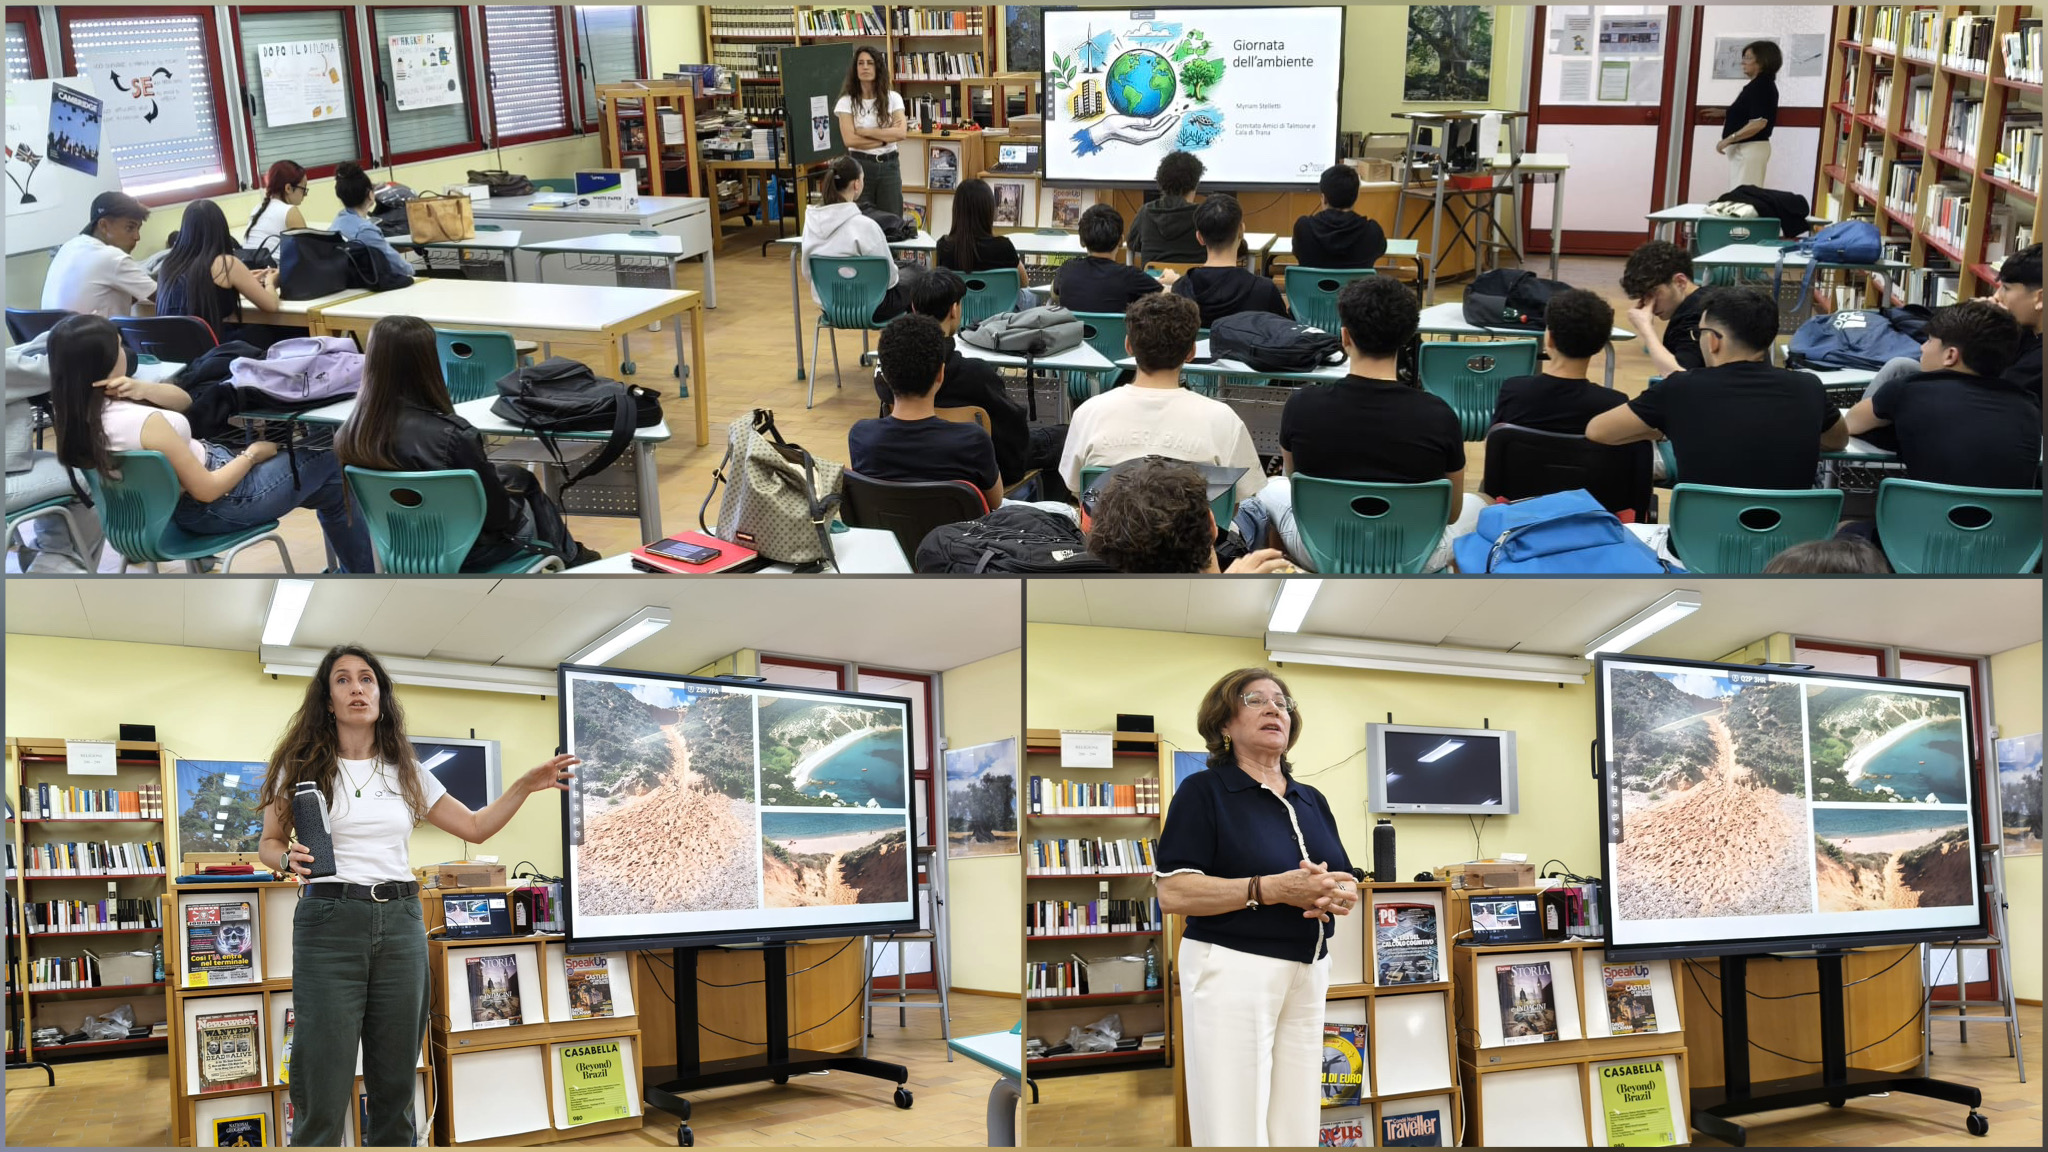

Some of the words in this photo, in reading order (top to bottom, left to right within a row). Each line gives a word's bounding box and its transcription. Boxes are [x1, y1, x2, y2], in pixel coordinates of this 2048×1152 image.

[1233, 39, 1285, 51] Giornata
[263, 46, 286, 58] DOPO
[1233, 55, 1314, 67] dell'ambiente
[131, 76, 156, 98] SE
[58, 92, 98, 112] CAMBRIDGE
[1740, 675, 1753, 683] Q2P
[1753, 676, 1767, 684] 3HR
[707, 687, 720, 695] 7PA
[1382, 940, 1406, 948] CALCOLO
[1406, 939, 1434, 947] COGNITIVO
[213, 958, 249, 967] terminale
[480, 957, 516, 969] STORIA
[565, 956, 607, 969] SpeakUp
[584, 973, 608, 981] CASTLES
[1511, 964, 1551, 978] STORIA
[1603, 965, 1649, 979] SpeakUp
[1625, 984, 1651, 992] CASTLES
[484, 991, 512, 999] INDAGINI
[1516, 1003, 1547, 1012] INDAGINI
[197, 1015, 257, 1030] Newsweek
[205, 1026, 251, 1037] WANTED
[206, 1054, 226, 1062] DEAD
[231, 1051, 252, 1059] ALIVE
[564, 1043, 618, 1058] CASABELLA
[575, 1059, 612, 1073] (Beyond)
[1603, 1062, 1663, 1078] CASABELLA
[582, 1068, 608, 1080] Brazil
[1328, 1073, 1338, 1084] DI
[1339, 1073, 1362, 1085] EURO
[1616, 1080, 1656, 1095] (Beyond)
[1623, 1091, 1652, 1103] Brazil
[1384, 1114, 1437, 1141] Traveller
[1320, 1125, 1363, 1143] ocus
